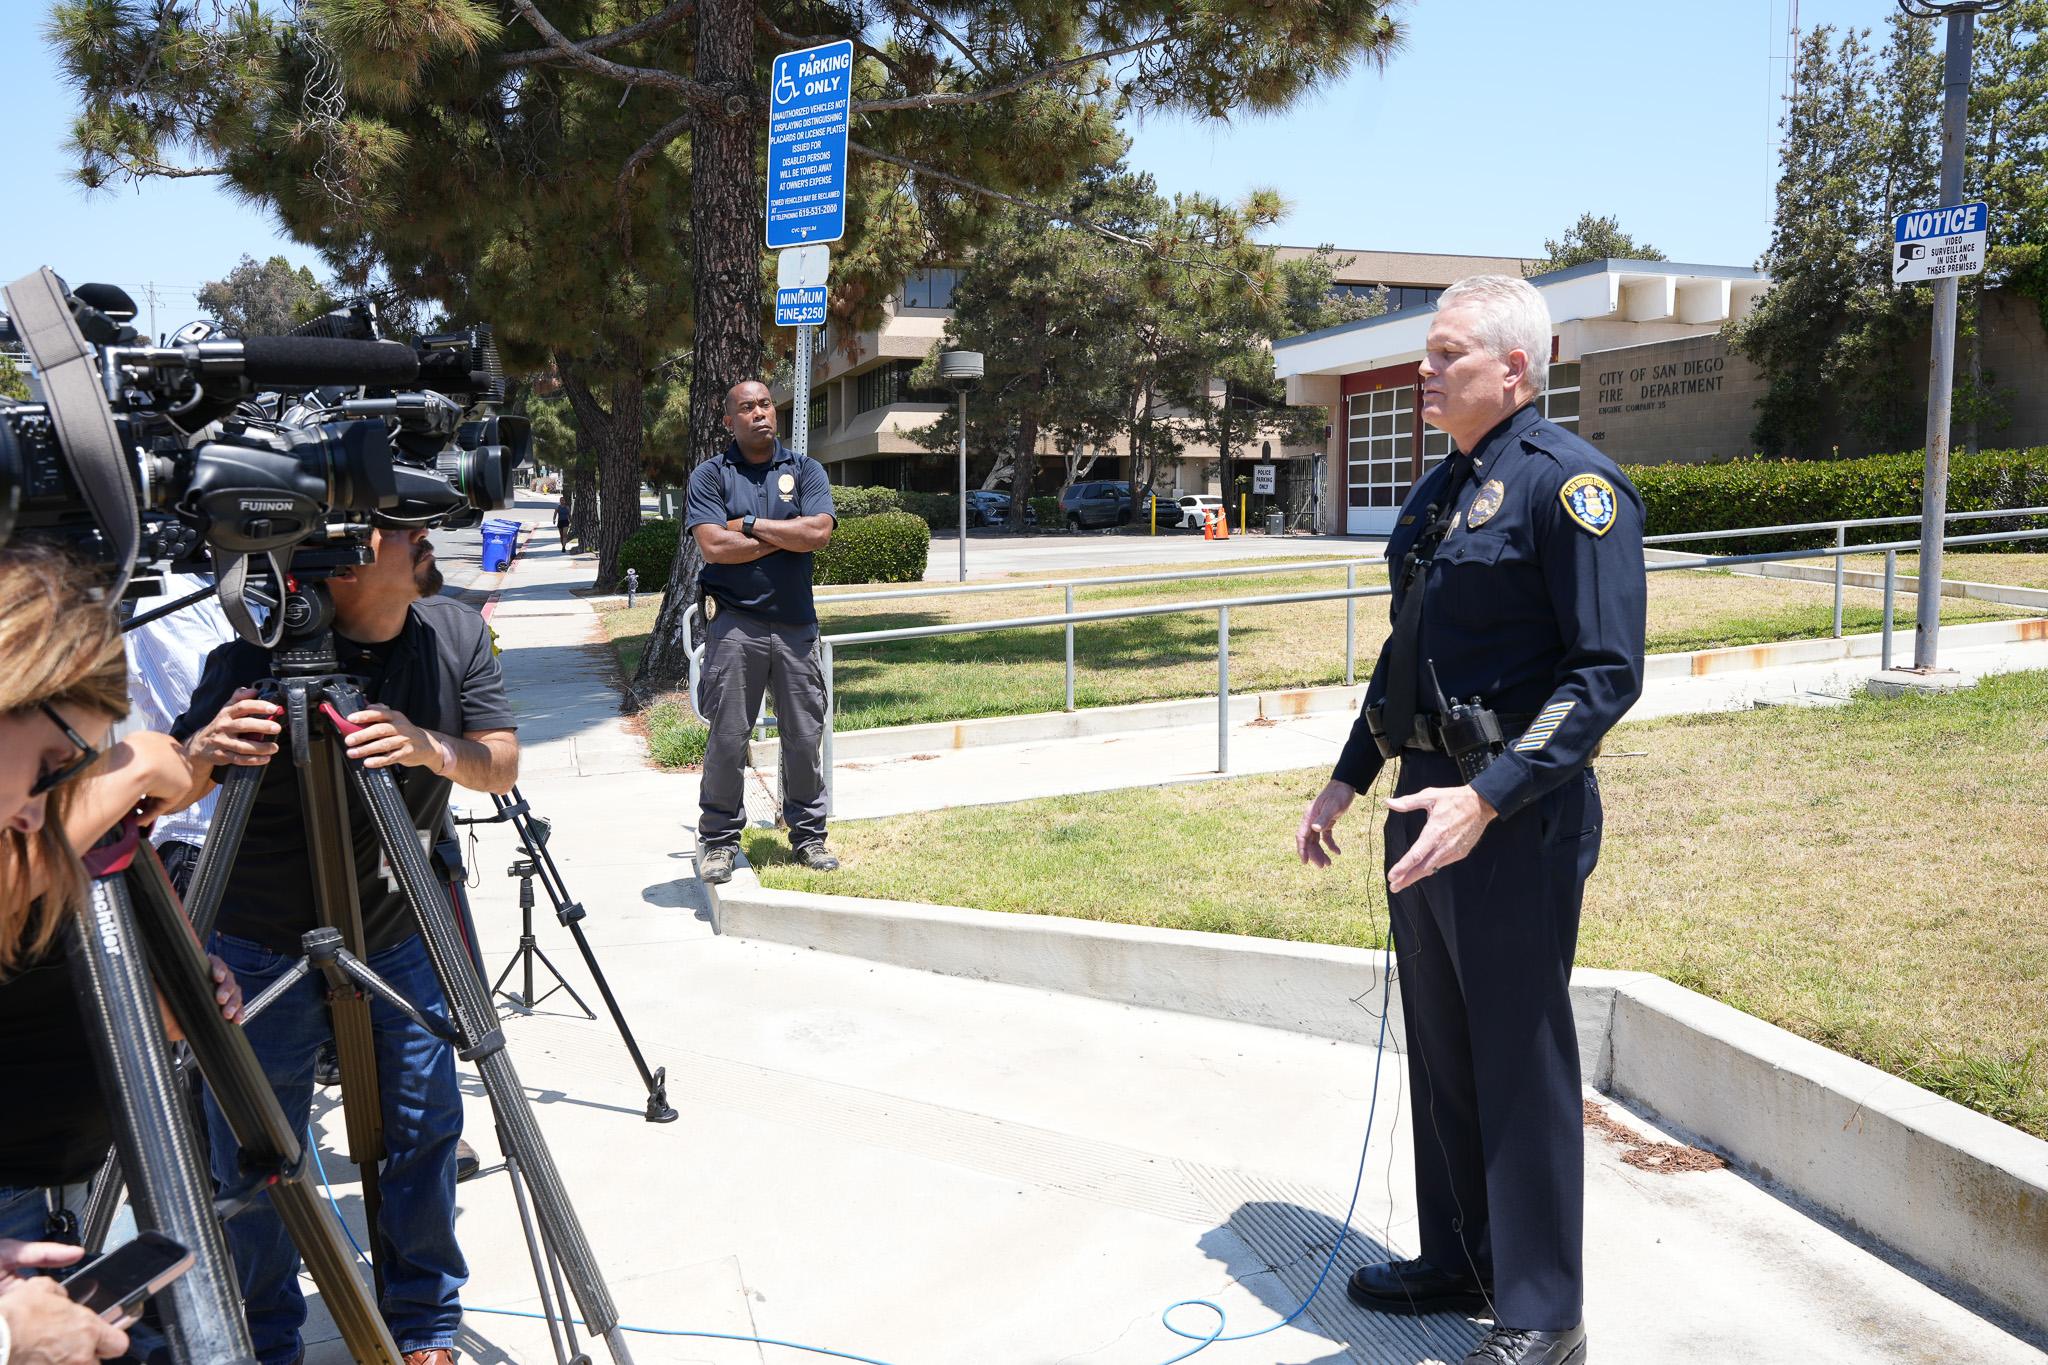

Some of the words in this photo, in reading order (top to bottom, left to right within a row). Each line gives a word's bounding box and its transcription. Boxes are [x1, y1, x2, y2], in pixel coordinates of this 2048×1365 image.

[799, 54, 849, 78] PARKING
[805, 76, 840, 96] ONLY
[773, 107, 809, 121] UNAUTHORIZED
[810, 102, 834, 113] VEHICLES
[835, 99, 846, 109] NOT
[774, 120, 802, 132] DISPLAYING
[803, 112, 842, 127] DISTINGUISHING
[770, 133, 796, 144] PLACARDS
[797, 132, 804, 140] OR
[805, 128, 825, 138] LICENSE
[826, 124, 845, 134] PLATES
[792, 143, 810, 153] ISSUED
[811, 141, 821, 149] FOR
[782, 155, 806, 166] DISABLED
[807, 151, 831, 162] PERSONS
[780, 170, 791, 179] WILL
[792, 168, 800, 177] BE
[800, 166, 817, 175] TOWED
[818, 163, 832, 173] AWAY
[779, 183, 786, 191] AT
[786, 179, 809, 190] OWNER'S
[809, 175, 832, 186] EXPENSE
[771, 198, 784, 206] TOWED
[785, 196, 802, 204] VEHICLES
[818, 190, 840, 200] RECLAIMED
[799, 204, 837, 217] 619-531-2000
[1904, 206, 1977, 239] NOTICE
[1945, 236, 1962, 245] VIDEO
[1931, 244, 1975, 256] SURVEILLANCE
[1937, 257, 1944, 265] IN
[1946, 255, 1956, 263] USE
[1959, 254, 1967, 262] ON
[1927, 266, 1945, 275] THESE
[1948, 262, 1976, 272] PREMISES
[780, 291, 823, 305] MINIMUM
[778, 308, 799, 320] FINE
[802, 307, 823, 320] $250
[1599, 371, 1624, 385] CITY
[1630, 368, 1646, 382] OF
[1653, 364, 1676, 380] SAN
[1684, 357, 1724, 376] DIEGO
[1599, 388, 1623, 402] FIRE
[1641, 376, 1724, 399] DEPARTMENT
[1599, 406, 1621, 414] ENGINE
[1626, 403, 1655, 412] COMPANY
[1564, 482, 1578, 496] SAN
[1576, 477, 1593, 486] DIEGO
[240, 501, 293, 511] FUJINON
